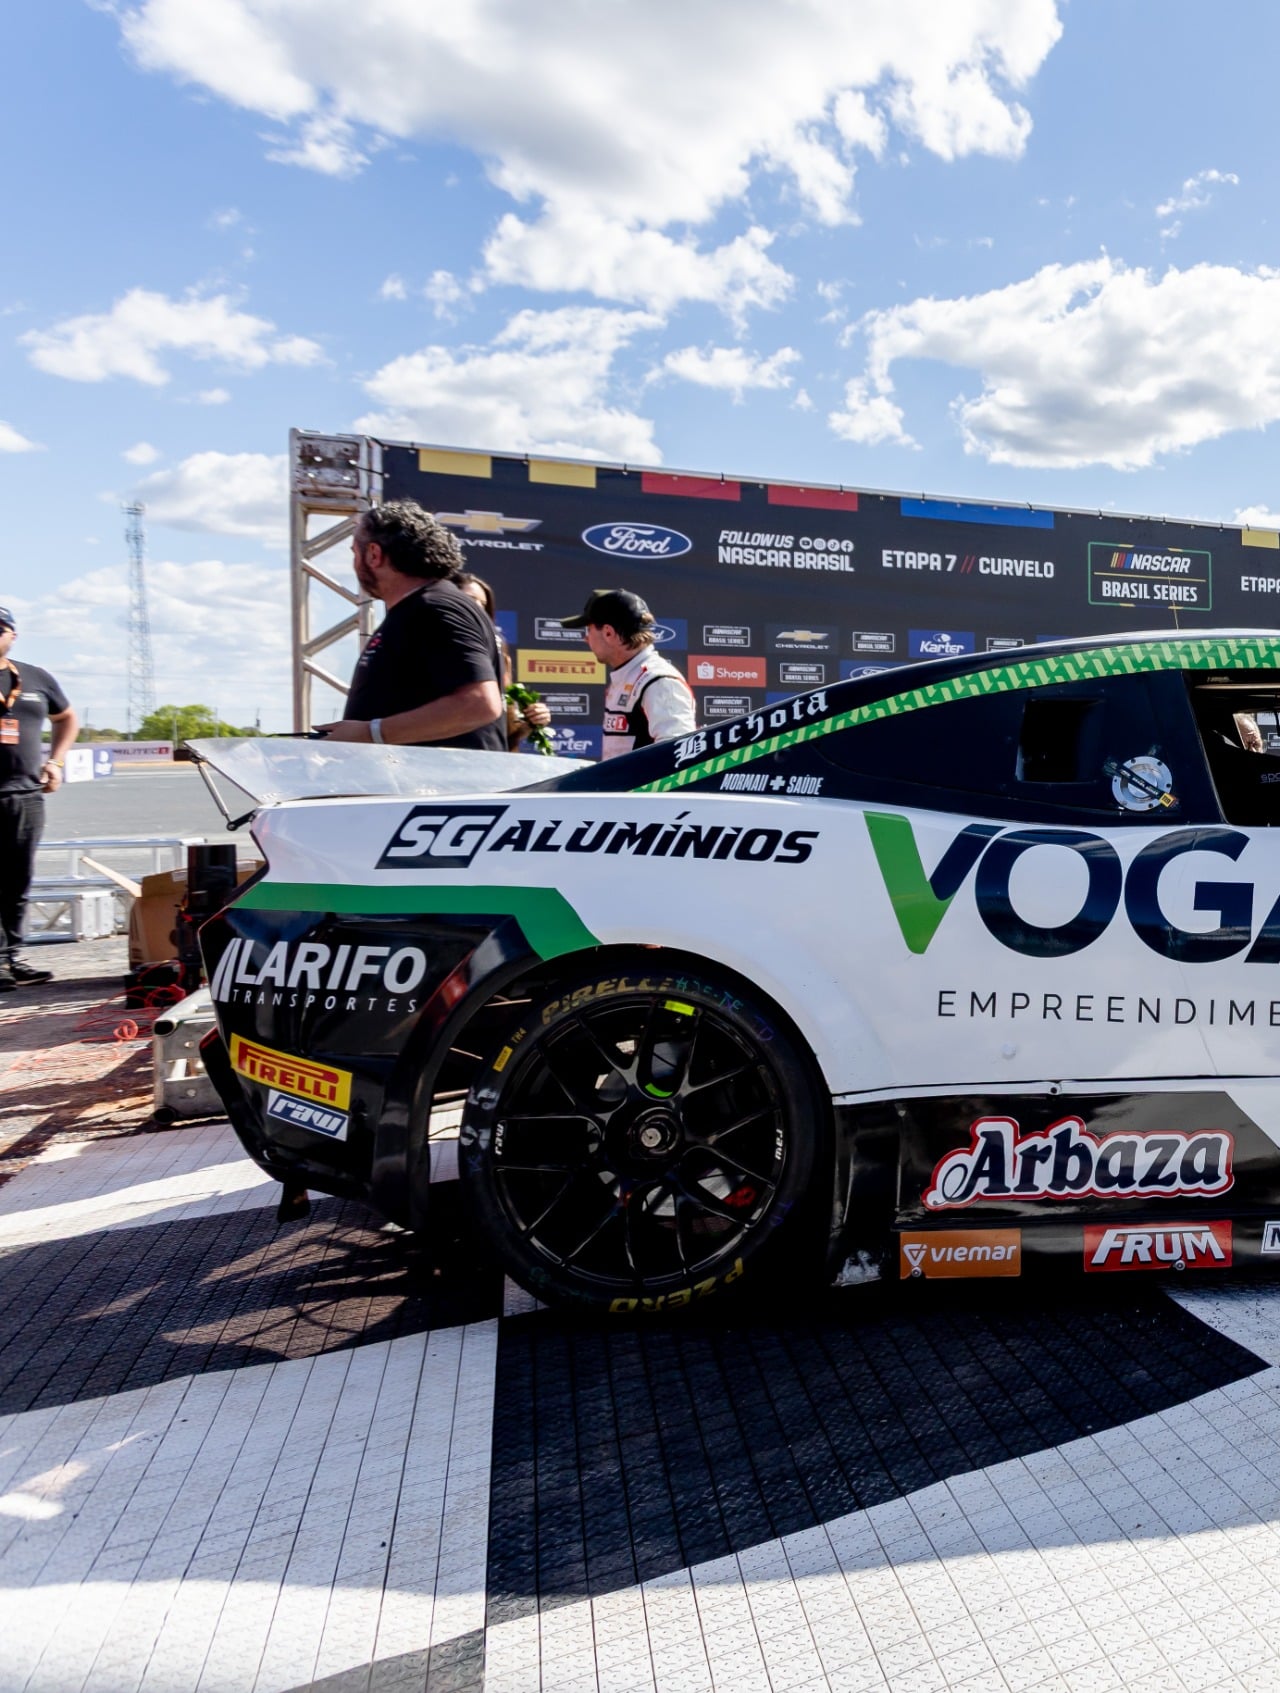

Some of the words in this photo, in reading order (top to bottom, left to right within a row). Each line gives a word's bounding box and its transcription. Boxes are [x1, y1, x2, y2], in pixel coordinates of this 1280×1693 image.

[458, 538, 544, 551] EVROLET
[604, 526, 672, 554] Ford
[718, 530, 775, 547] FOLLOW
[775, 534, 795, 549] US
[718, 546, 791, 568] NASCAR
[793, 552, 855, 572] BRASIL
[882, 549, 942, 571] ETAPA
[945, 554, 957, 572] 7
[979, 557, 1055, 579] CURVELO
[1130, 553, 1191, 574] NASCAR
[1101, 580, 1150, 600] BRASIL
[1153, 584, 1198, 602] SERIES
[920, 640, 965, 654] Karter
[528, 659, 596, 674] PIRELLI
[716, 667, 759, 681] Shopee
[674, 689, 829, 769] Bichota
[535, 737, 593, 751] arter
[786, 774, 824, 795] SAÚDE
[386, 815, 496, 857] SG
[487, 811, 820, 864] ALUMÍNIOS
[234, 939, 427, 994] LARIFO
[233, 988, 417, 1013] TRANSPORTES
[541, 976, 674, 1025] PIRELLI
[238, 1040, 340, 1103] PIRELLI
[272, 1096, 341, 1131] raw
[494, 1122, 505, 1157] raw
[774, 1128, 784, 1161] raw
[932, 1127, 1223, 1206] Arbaza
[931, 1243, 1017, 1263] viemar
[1090, 1226, 1226, 1265] FRUM
